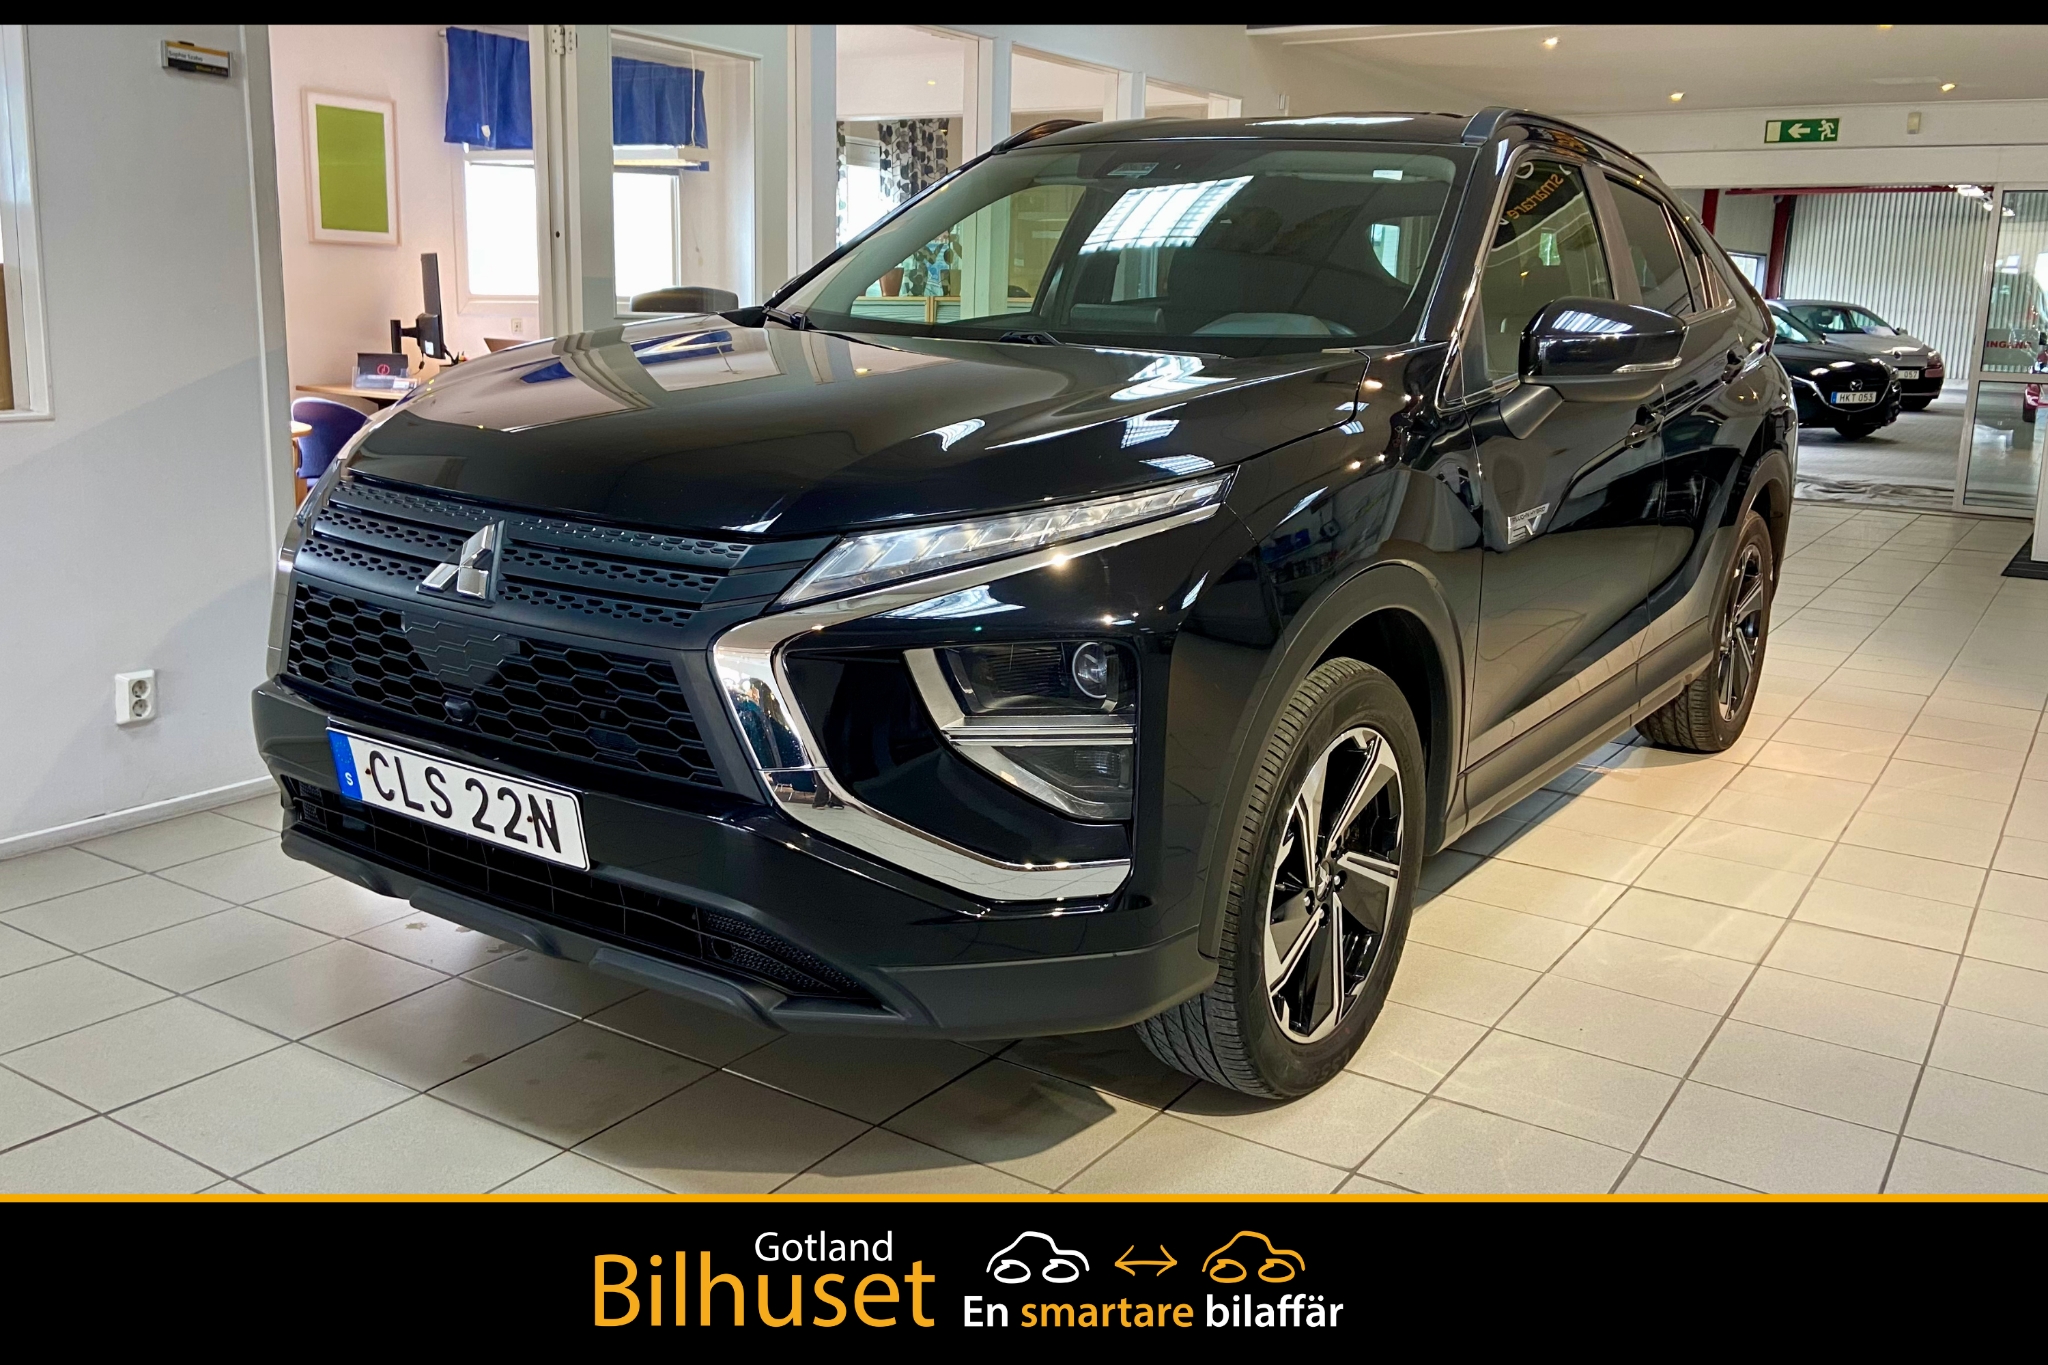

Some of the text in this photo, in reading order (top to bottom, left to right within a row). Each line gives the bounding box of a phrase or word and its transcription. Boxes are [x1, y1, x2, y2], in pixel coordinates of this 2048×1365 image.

[1840, 392, 1874, 402] HKT 053
[344, 750, 562, 854] S CLS 22N
